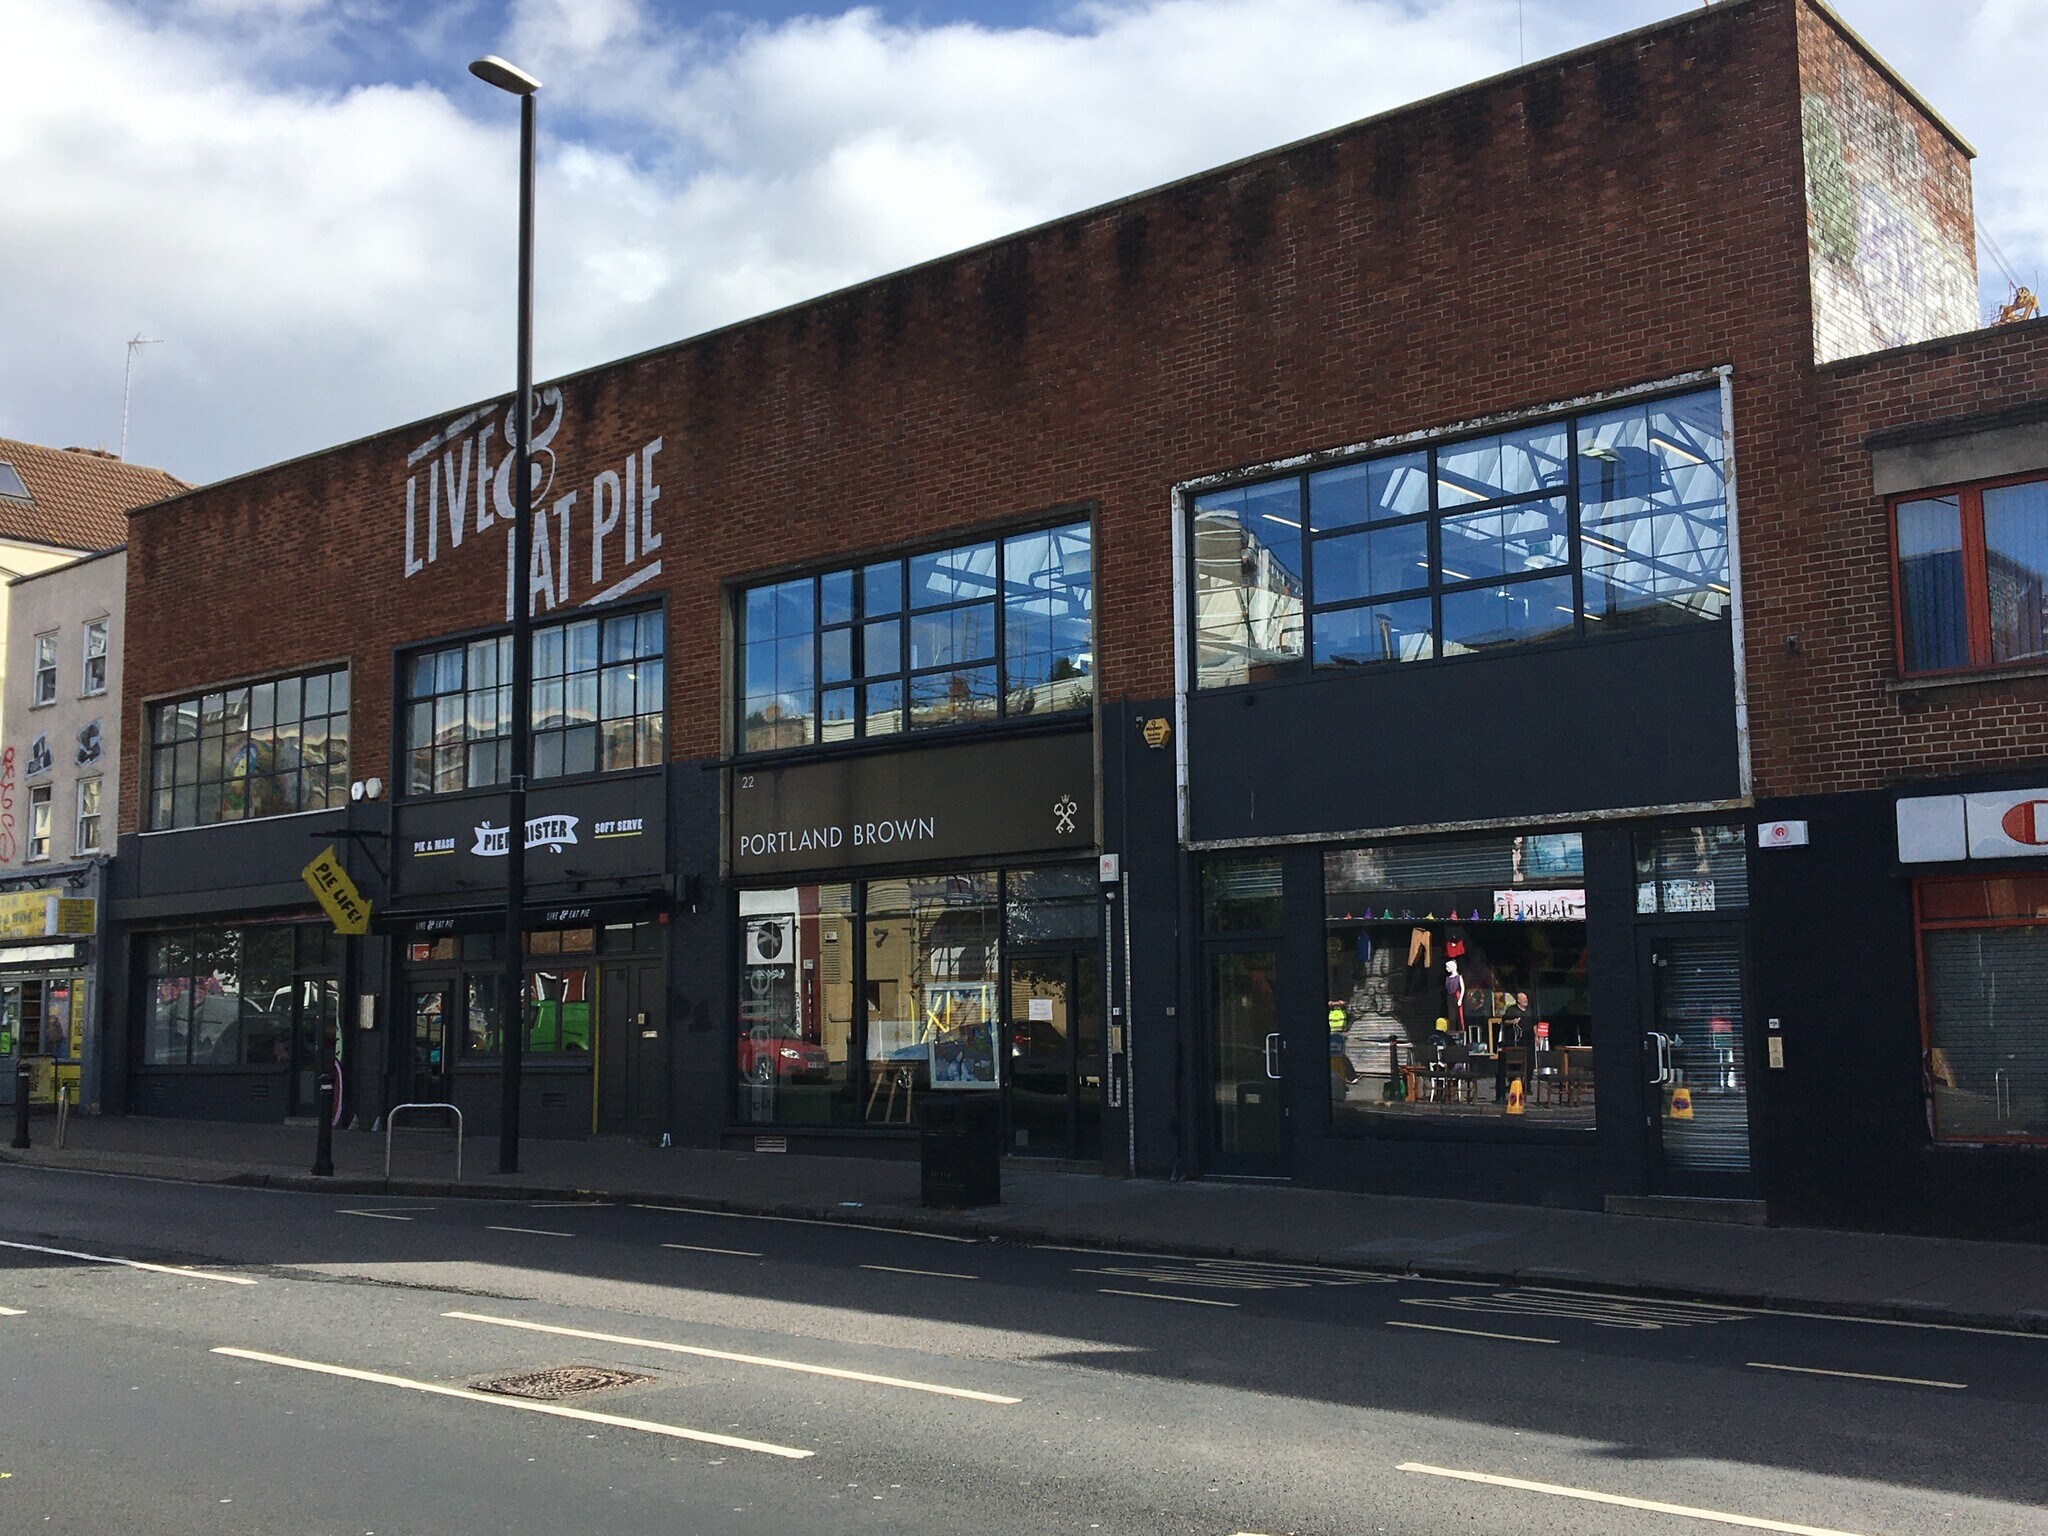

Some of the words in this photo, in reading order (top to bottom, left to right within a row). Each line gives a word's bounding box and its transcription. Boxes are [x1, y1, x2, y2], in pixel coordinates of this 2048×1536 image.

[404, 422, 495, 579] LIVE
[492, 386, 564, 519] &
[591, 436, 663, 585] PIE
[742, 775, 754, 789] 22
[483, 820, 568, 852] PIEISTER
[594, 821, 615, 834] SOFT
[616, 818, 643, 832] SERVE
[740, 826, 843, 856] PORTLAND
[853, 816, 935, 846] BROWN
[414, 840, 426, 852] PIE
[434, 838, 455, 850] MASH
[315, 862, 338, 888] PIE
[333, 888, 363, 924] LIFE!
